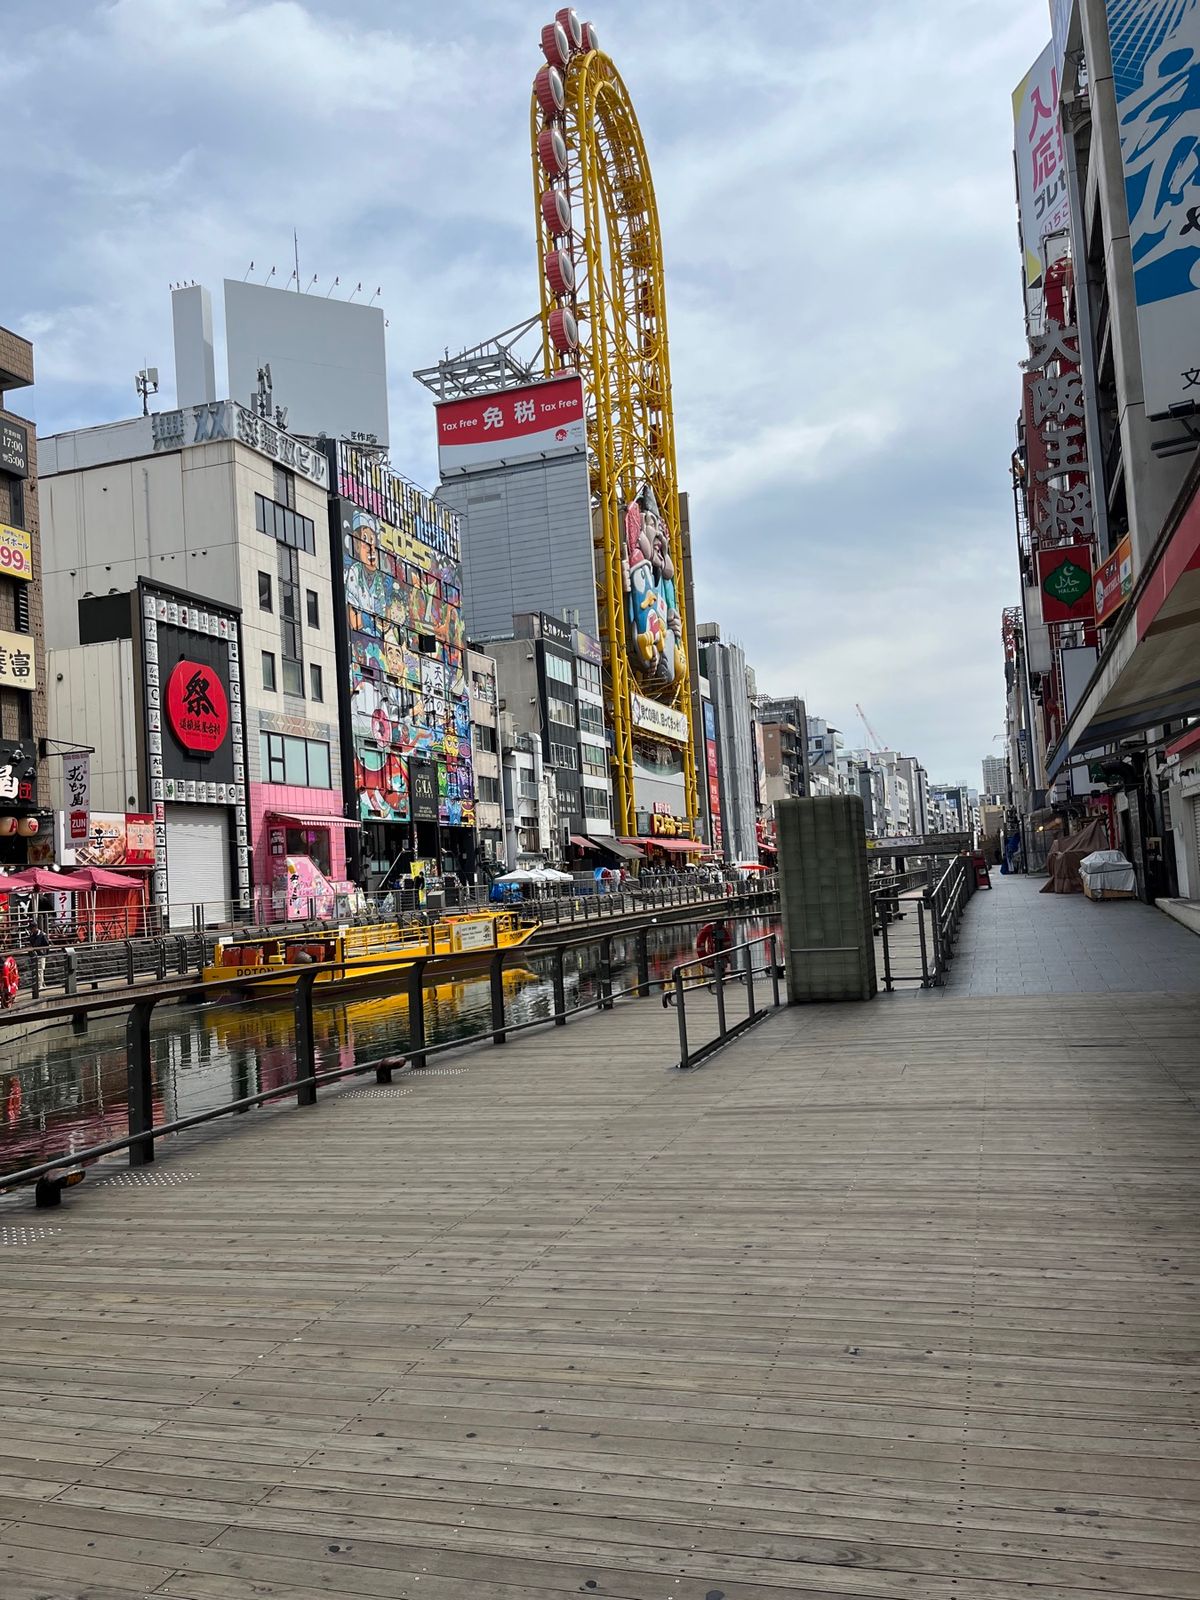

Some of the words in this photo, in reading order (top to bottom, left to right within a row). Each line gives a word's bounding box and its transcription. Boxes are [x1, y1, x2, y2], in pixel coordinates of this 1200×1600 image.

[540, 403, 557, 412] Tax
[558, 399, 578, 409] Free
[442, 423, 458, 432] Tax
[459, 418, 478, 428] Free
[1018, 319, 1092, 541] 大阪王将
[3, 436, 23, 453] 17:00
[380, 520, 432, 570] 2025
[1058, 587, 1080, 595] HALAL
[182, 670, 219, 718] 祭
